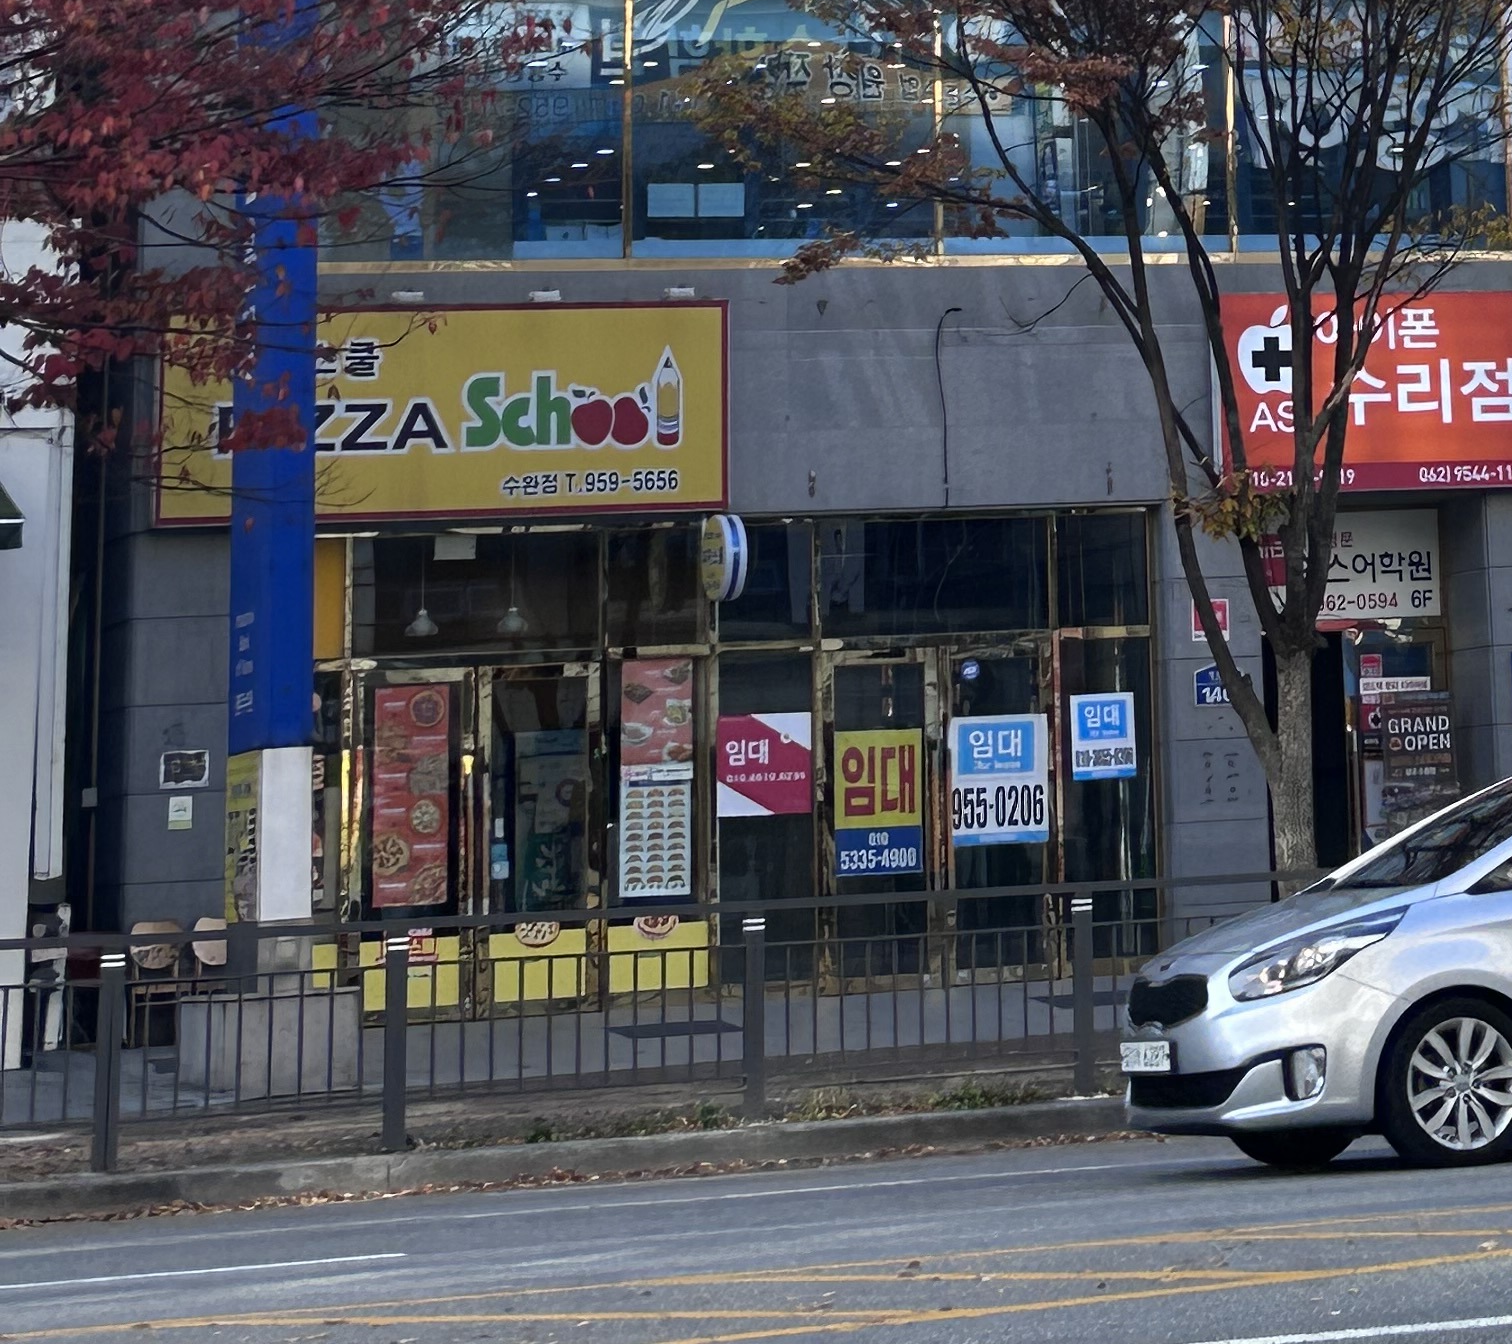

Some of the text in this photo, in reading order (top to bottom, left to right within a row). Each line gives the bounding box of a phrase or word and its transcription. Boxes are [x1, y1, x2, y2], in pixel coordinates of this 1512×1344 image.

[503, 474, 559, 496] 수완점
[1410, 589, 1434, 609] 6F
[1083, 704, 1120, 729] 임대
[1388, 715, 1451, 734] GRAND
[725, 738, 770, 767] 임대
[969, 729, 1023, 759] 임대
[1404, 733, 1451, 752] OPEN
[841, 744, 916, 817] 임대
[868, 831, 890, 846] 010
